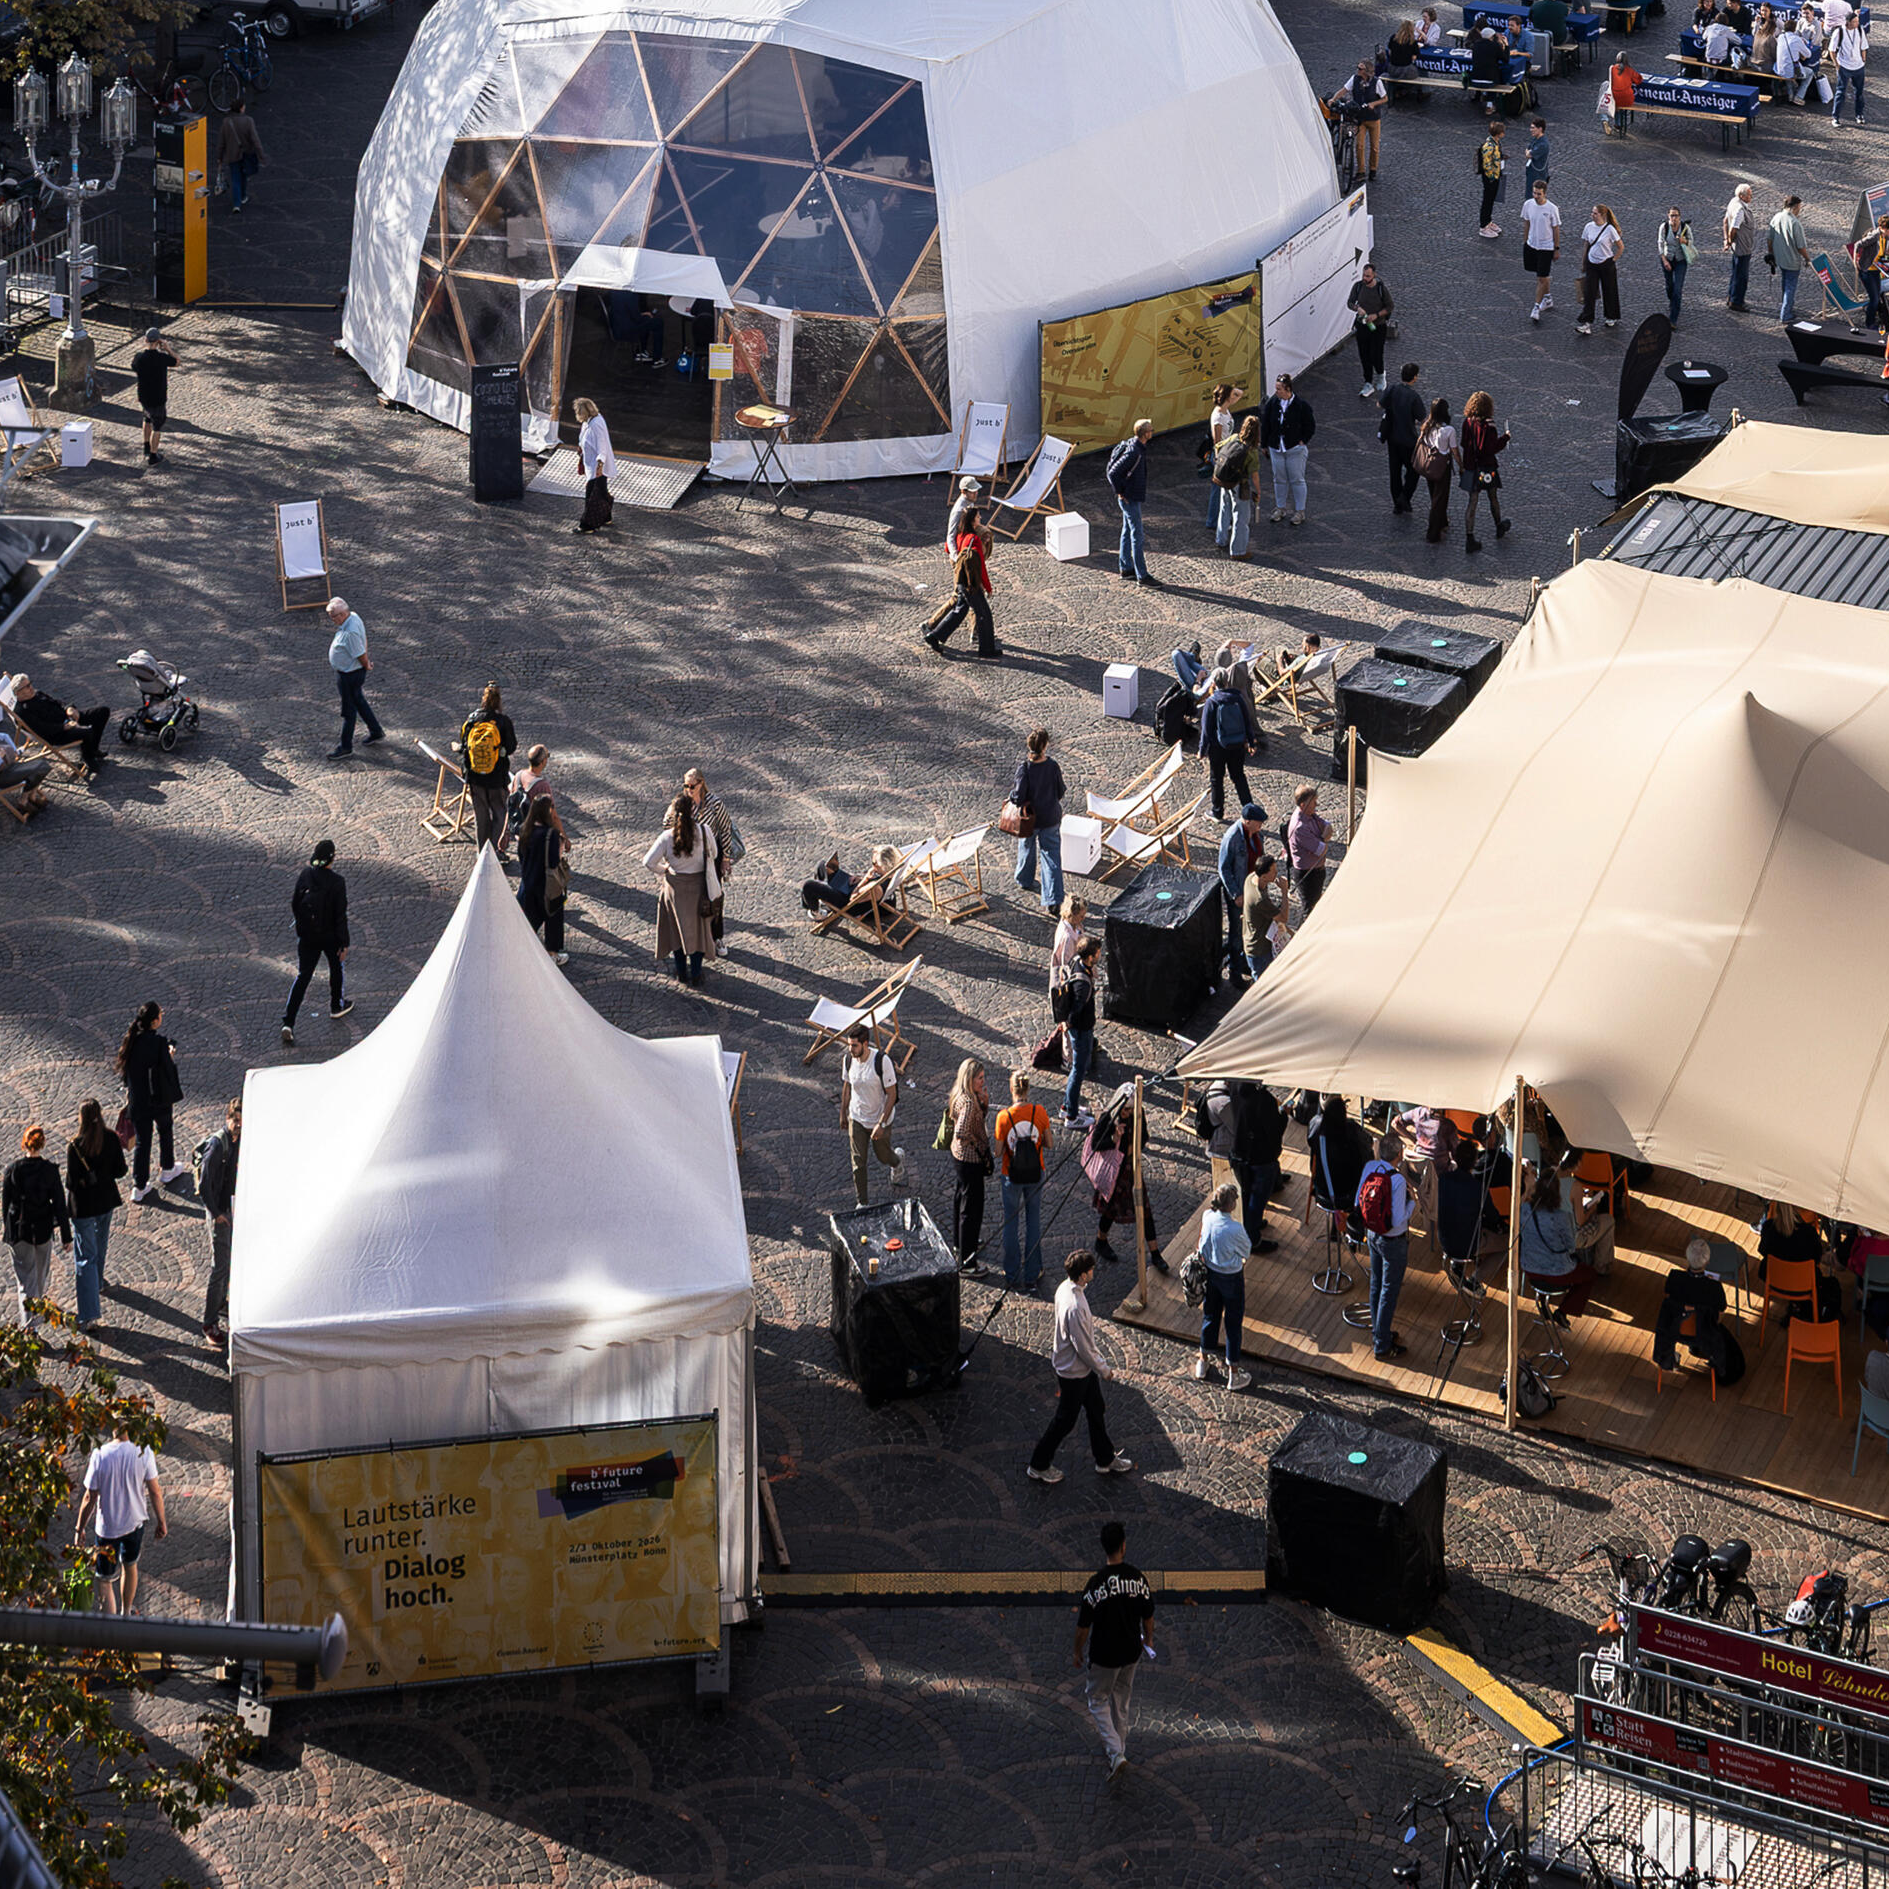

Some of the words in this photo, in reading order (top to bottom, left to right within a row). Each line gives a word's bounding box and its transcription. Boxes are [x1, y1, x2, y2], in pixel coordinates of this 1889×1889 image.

[975, 418, 993, 426] just
[1042, 453, 1056, 462] just
[286, 519, 304, 530] just
[571, 1478, 621, 1492] festival
[343, 1494, 476, 1529] Lautstärke
[344, 1529, 426, 1555] runter.
[569, 1544, 587, 1554] 2/3
[592, 1539, 633, 1551] Oktober
[569, 1552, 638, 1565] Münsterplatz
[644, 1547, 667, 1557] Bonn
[385, 1553, 466, 1580] Dialog
[385, 1582, 454, 1610] hoch.
[1084, 1588, 1108, 1609] Los
[654, 1637, 706, 1647] b-future.org
[1664, 1628, 1708, 1647] 0228-634726
[1761, 1650, 1812, 1681] Hotel
[1616, 1716, 1645, 1734] Statt
[1616, 1728, 1652, 1748] Reisen
[1725, 1747, 1776, 1767] Stadtführungen
[1725, 1758, 1759, 1773] Radtouren
[1797, 1767, 1847, 1787] Umland-Touren
